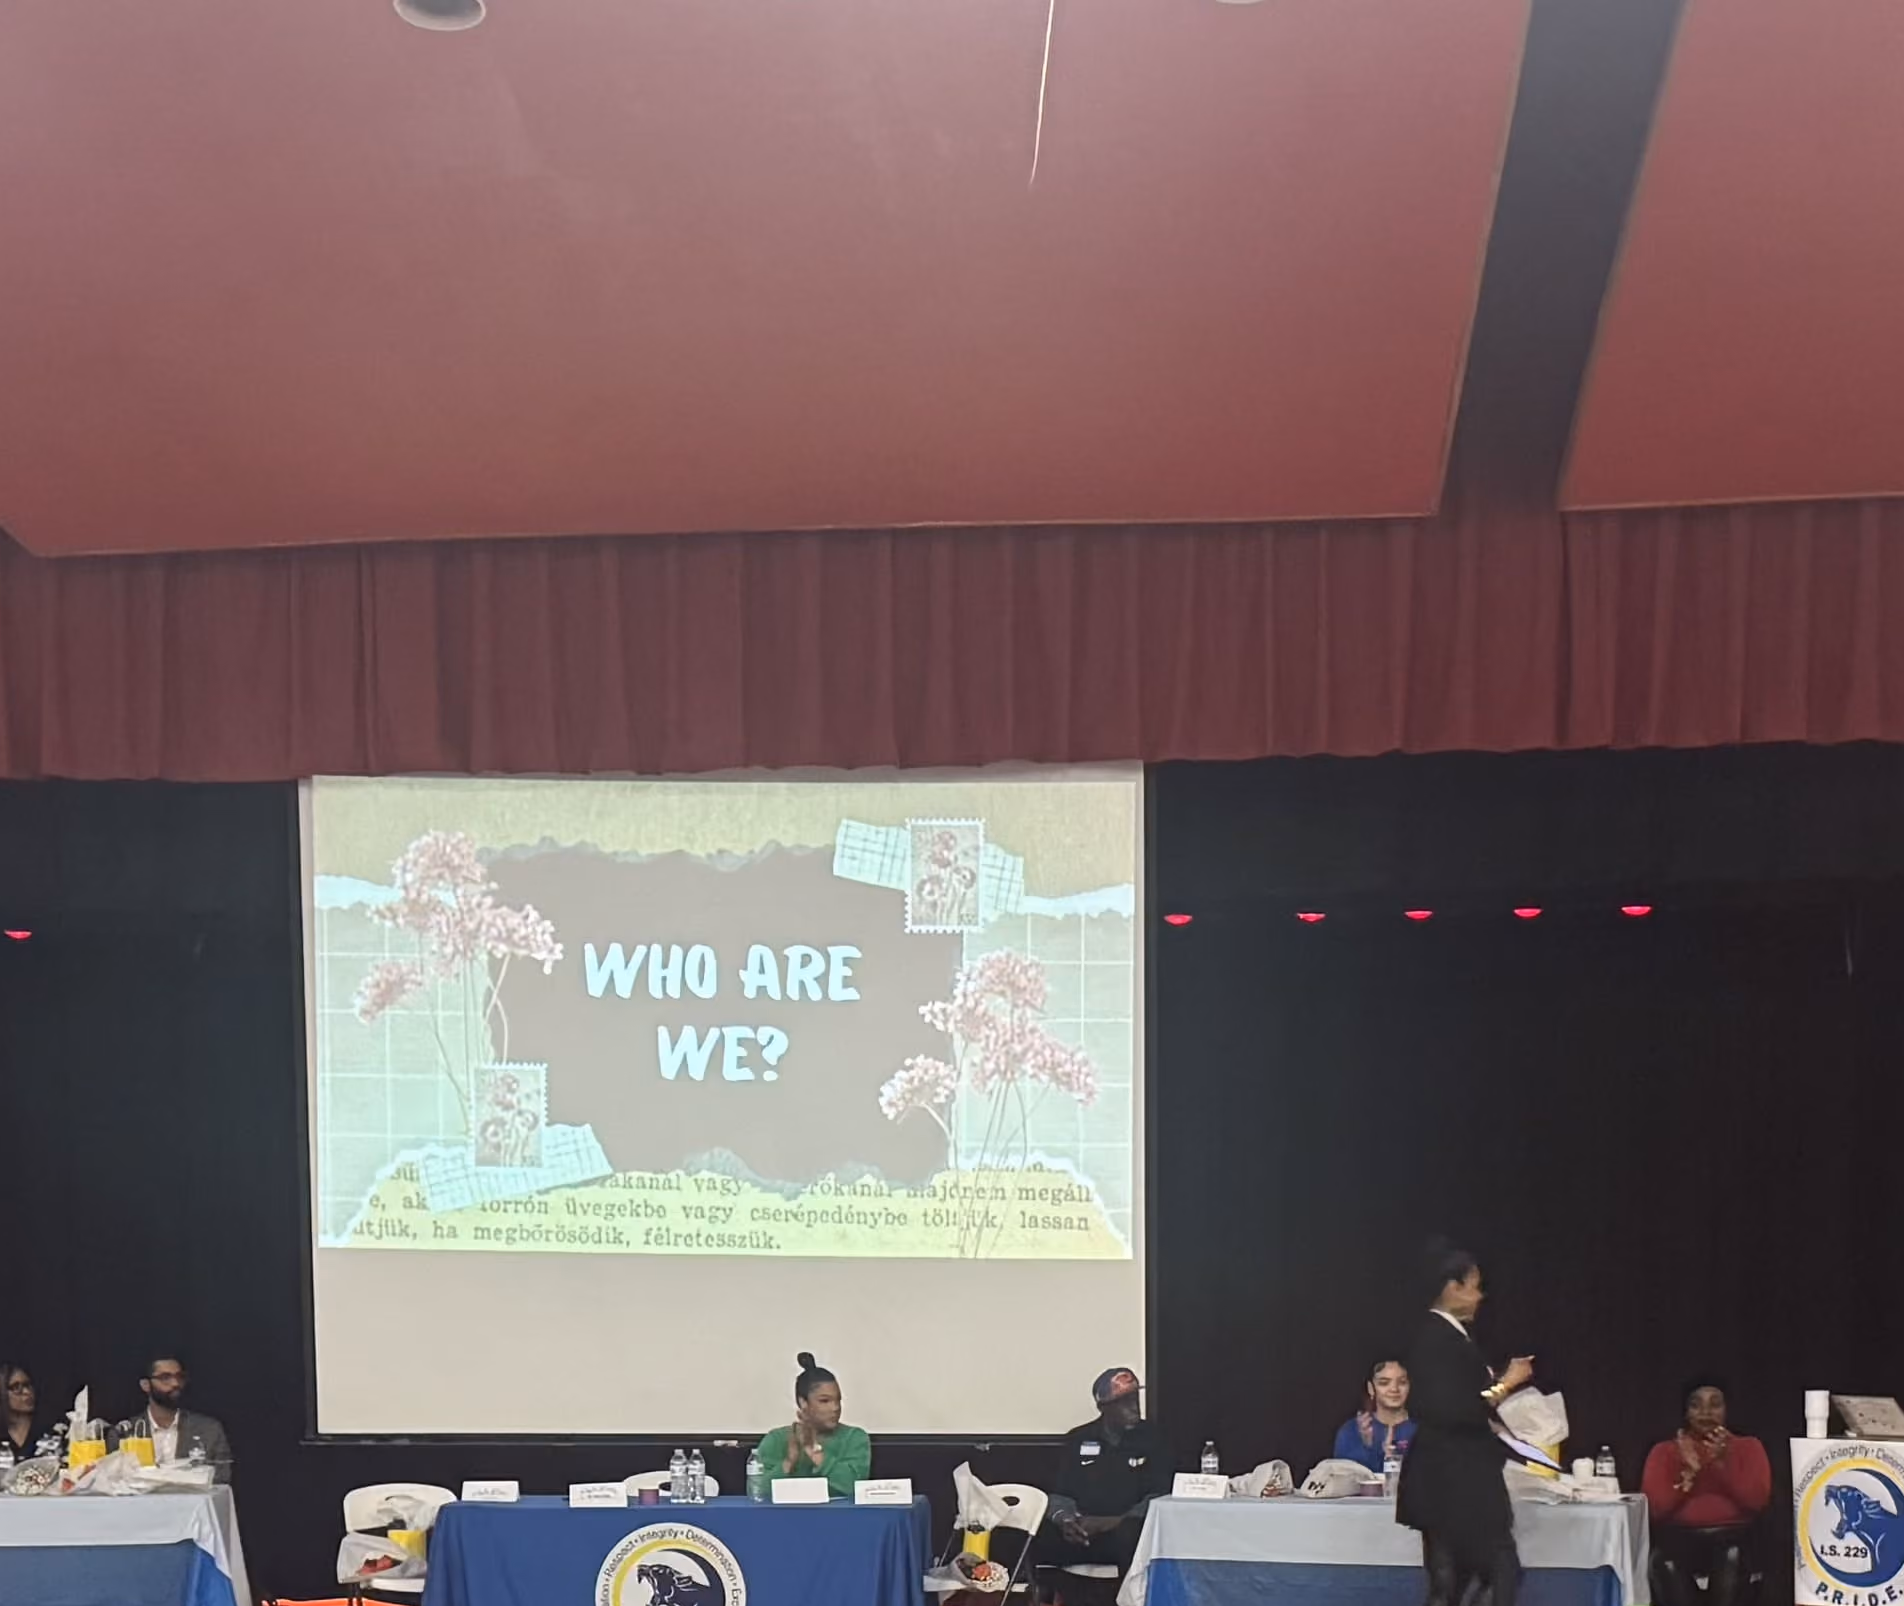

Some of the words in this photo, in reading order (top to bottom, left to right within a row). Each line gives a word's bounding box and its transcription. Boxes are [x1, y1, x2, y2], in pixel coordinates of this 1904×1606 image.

[584, 941, 718, 1001] WHO
[739, 944, 862, 1003] ARE
[657, 1024, 790, 1083] WE?
[694, 1175, 741, 1197] vagy
[1018, 1187, 1093, 1207] megáll
[433, 1220, 458, 1240] ha
[681, 1204, 733, 1226] vagy
[1020, 1211, 1090, 1232] lassan
[1844, 1546, 1868, 1558] 229
